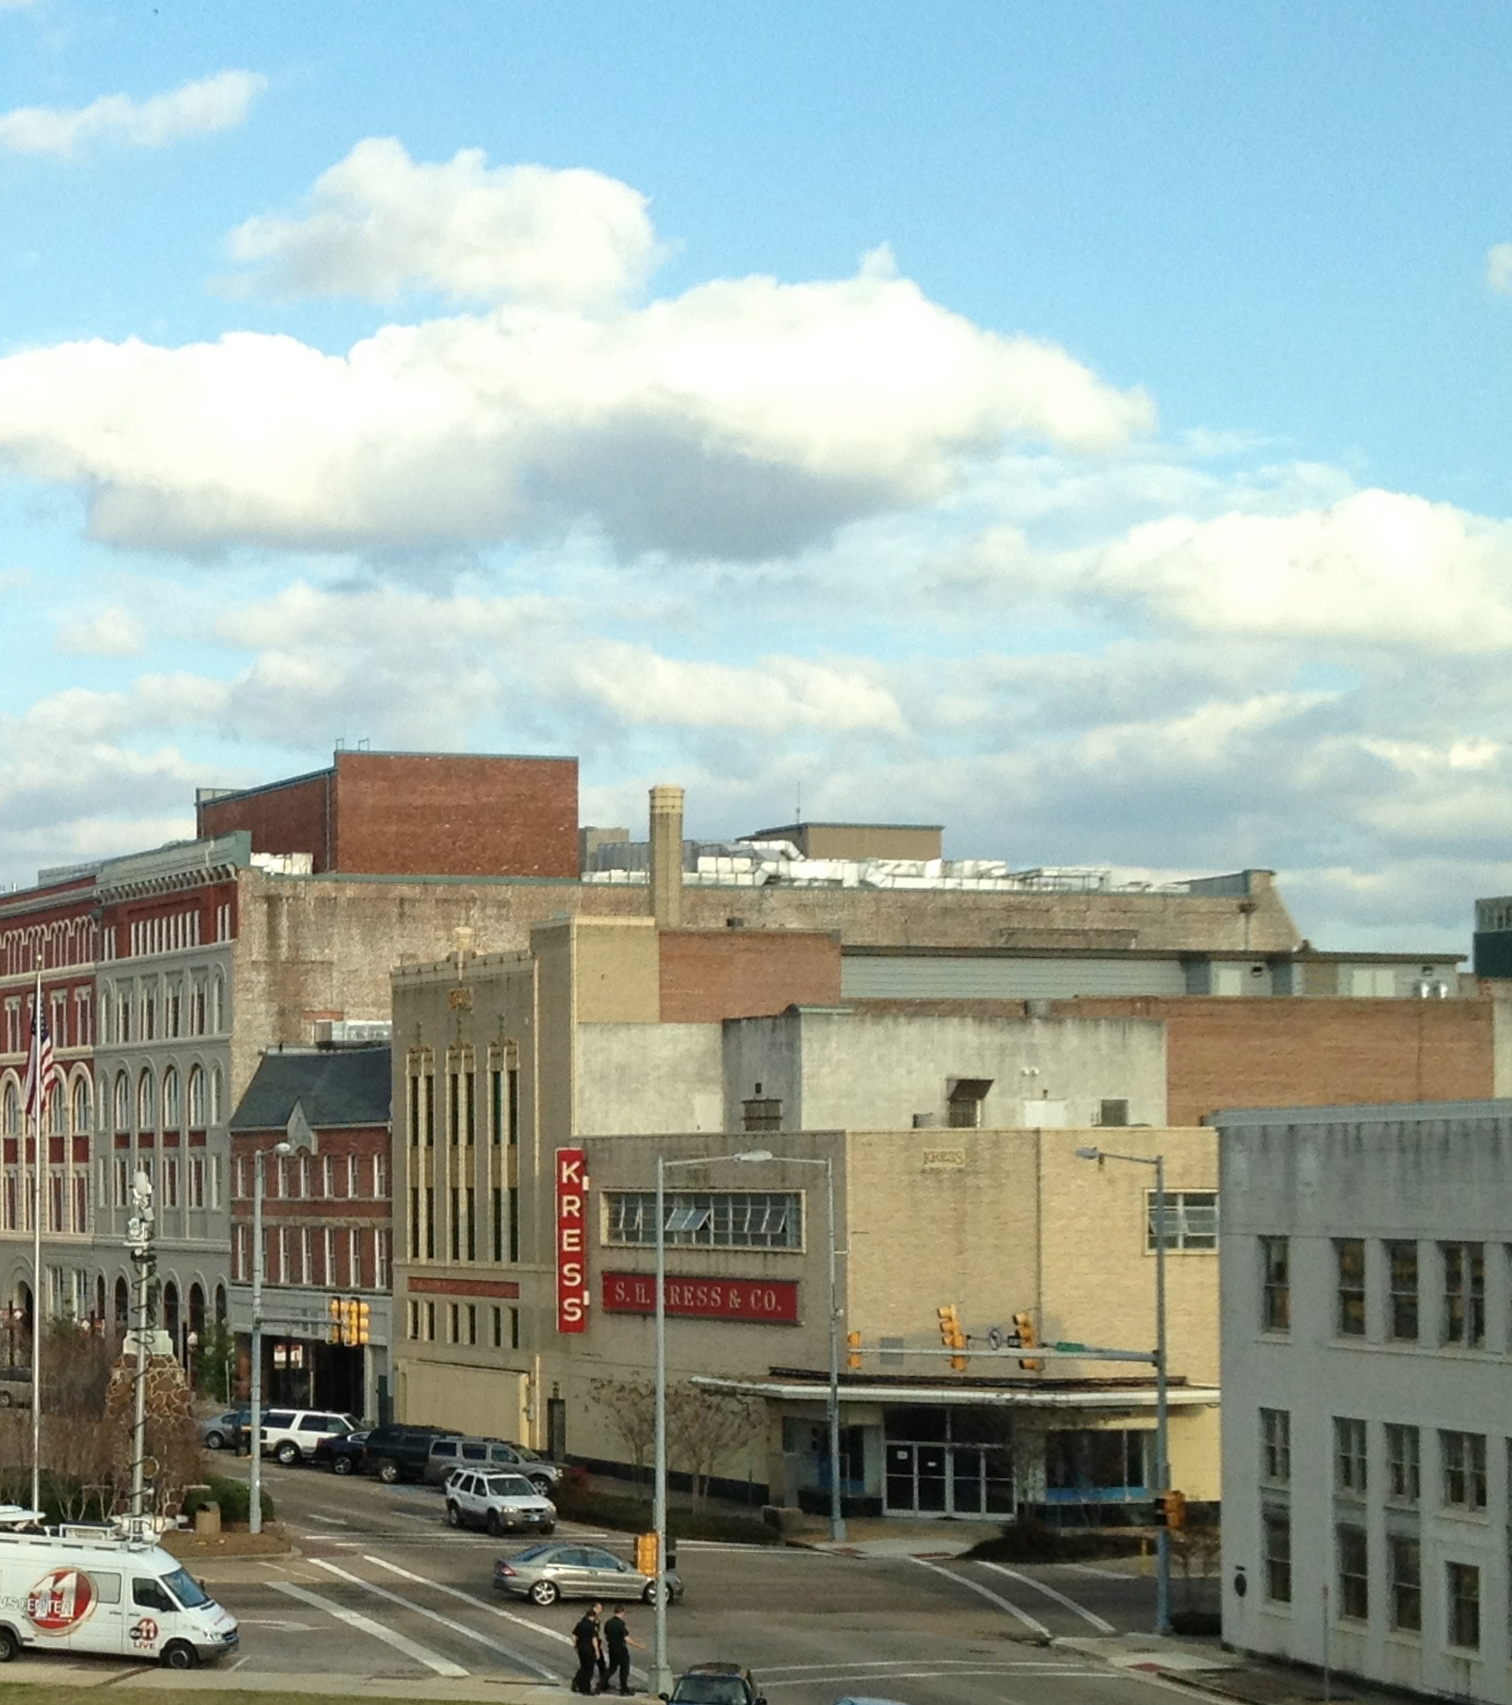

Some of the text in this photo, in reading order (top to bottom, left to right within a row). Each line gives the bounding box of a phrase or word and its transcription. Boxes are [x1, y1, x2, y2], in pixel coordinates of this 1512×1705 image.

[561, 1160, 582, 1323] KRESS
[615, 1281, 782, 1311] S. H. RESS & CO.
